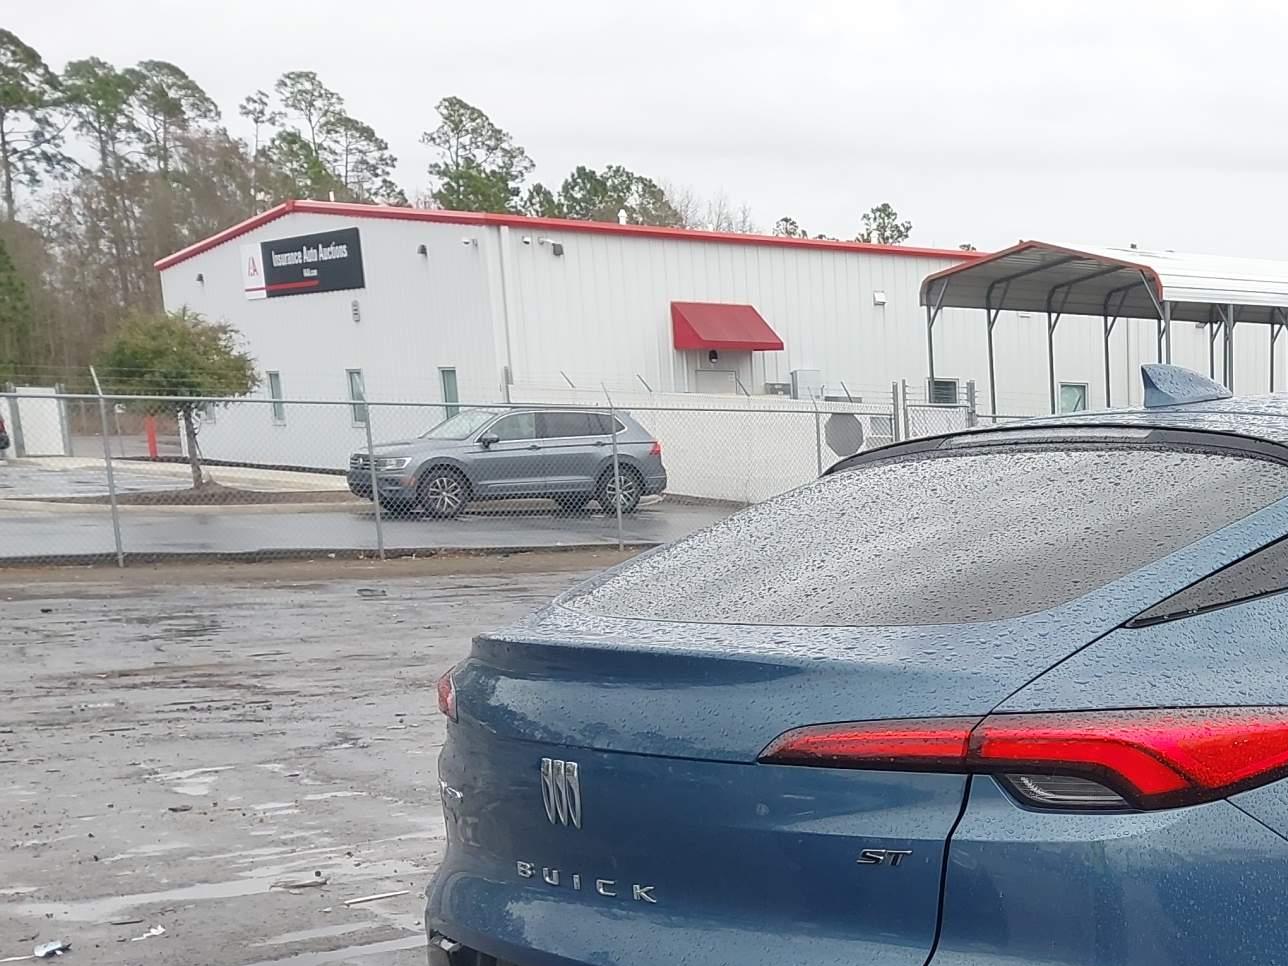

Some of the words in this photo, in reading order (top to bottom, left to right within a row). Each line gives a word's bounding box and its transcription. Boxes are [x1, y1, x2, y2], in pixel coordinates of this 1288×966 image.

[272, 250, 303, 267] Insurance
[303, 245, 318, 263] Auto
[318, 241, 348, 261] Auctions
[856, 848, 913, 866] ST
[516, 860, 658, 904] BUICK
